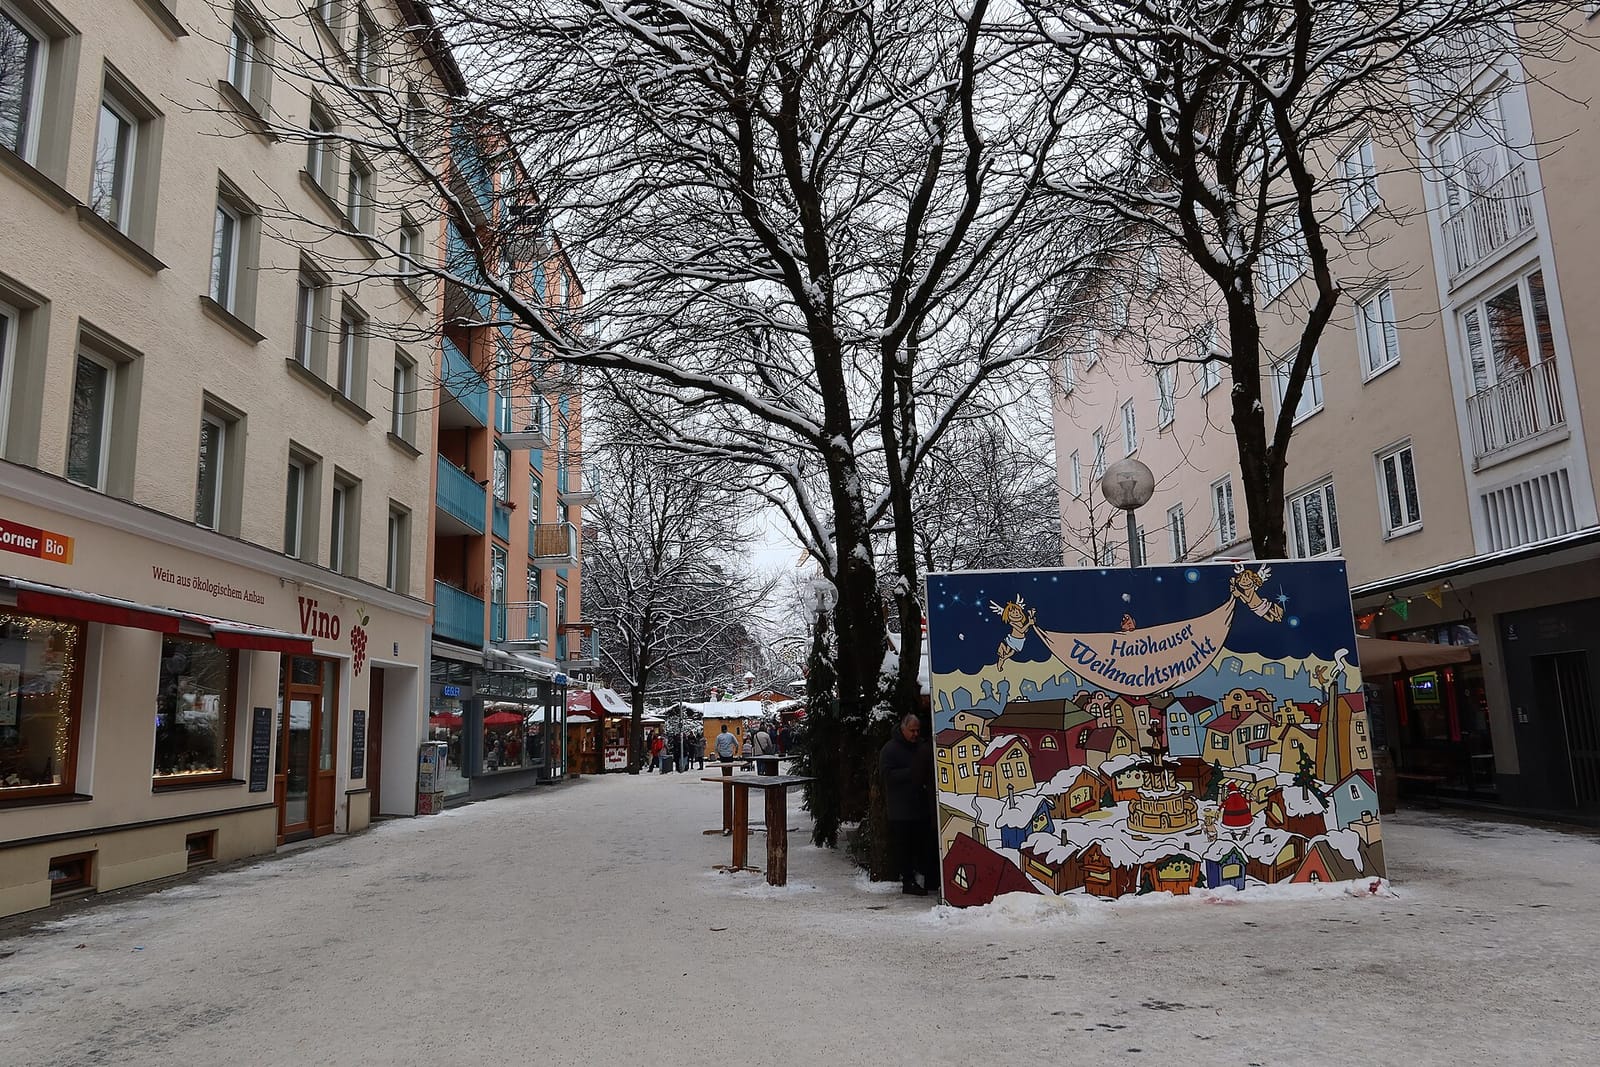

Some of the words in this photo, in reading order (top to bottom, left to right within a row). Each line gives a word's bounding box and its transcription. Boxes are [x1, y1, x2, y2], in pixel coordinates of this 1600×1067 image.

[45, 538, 64, 556] Bio
[152, 566, 175, 584] Wein
[176, 575, 191, 588] aus
[192, 576, 242, 598] ökologischem
[243, 589, 265, 605] Anbau
[298, 596, 340, 641] Vino
[1110, 623, 1194, 657] Haidhauser
[1070, 635, 1217, 687] Weihnachtsmarkt
